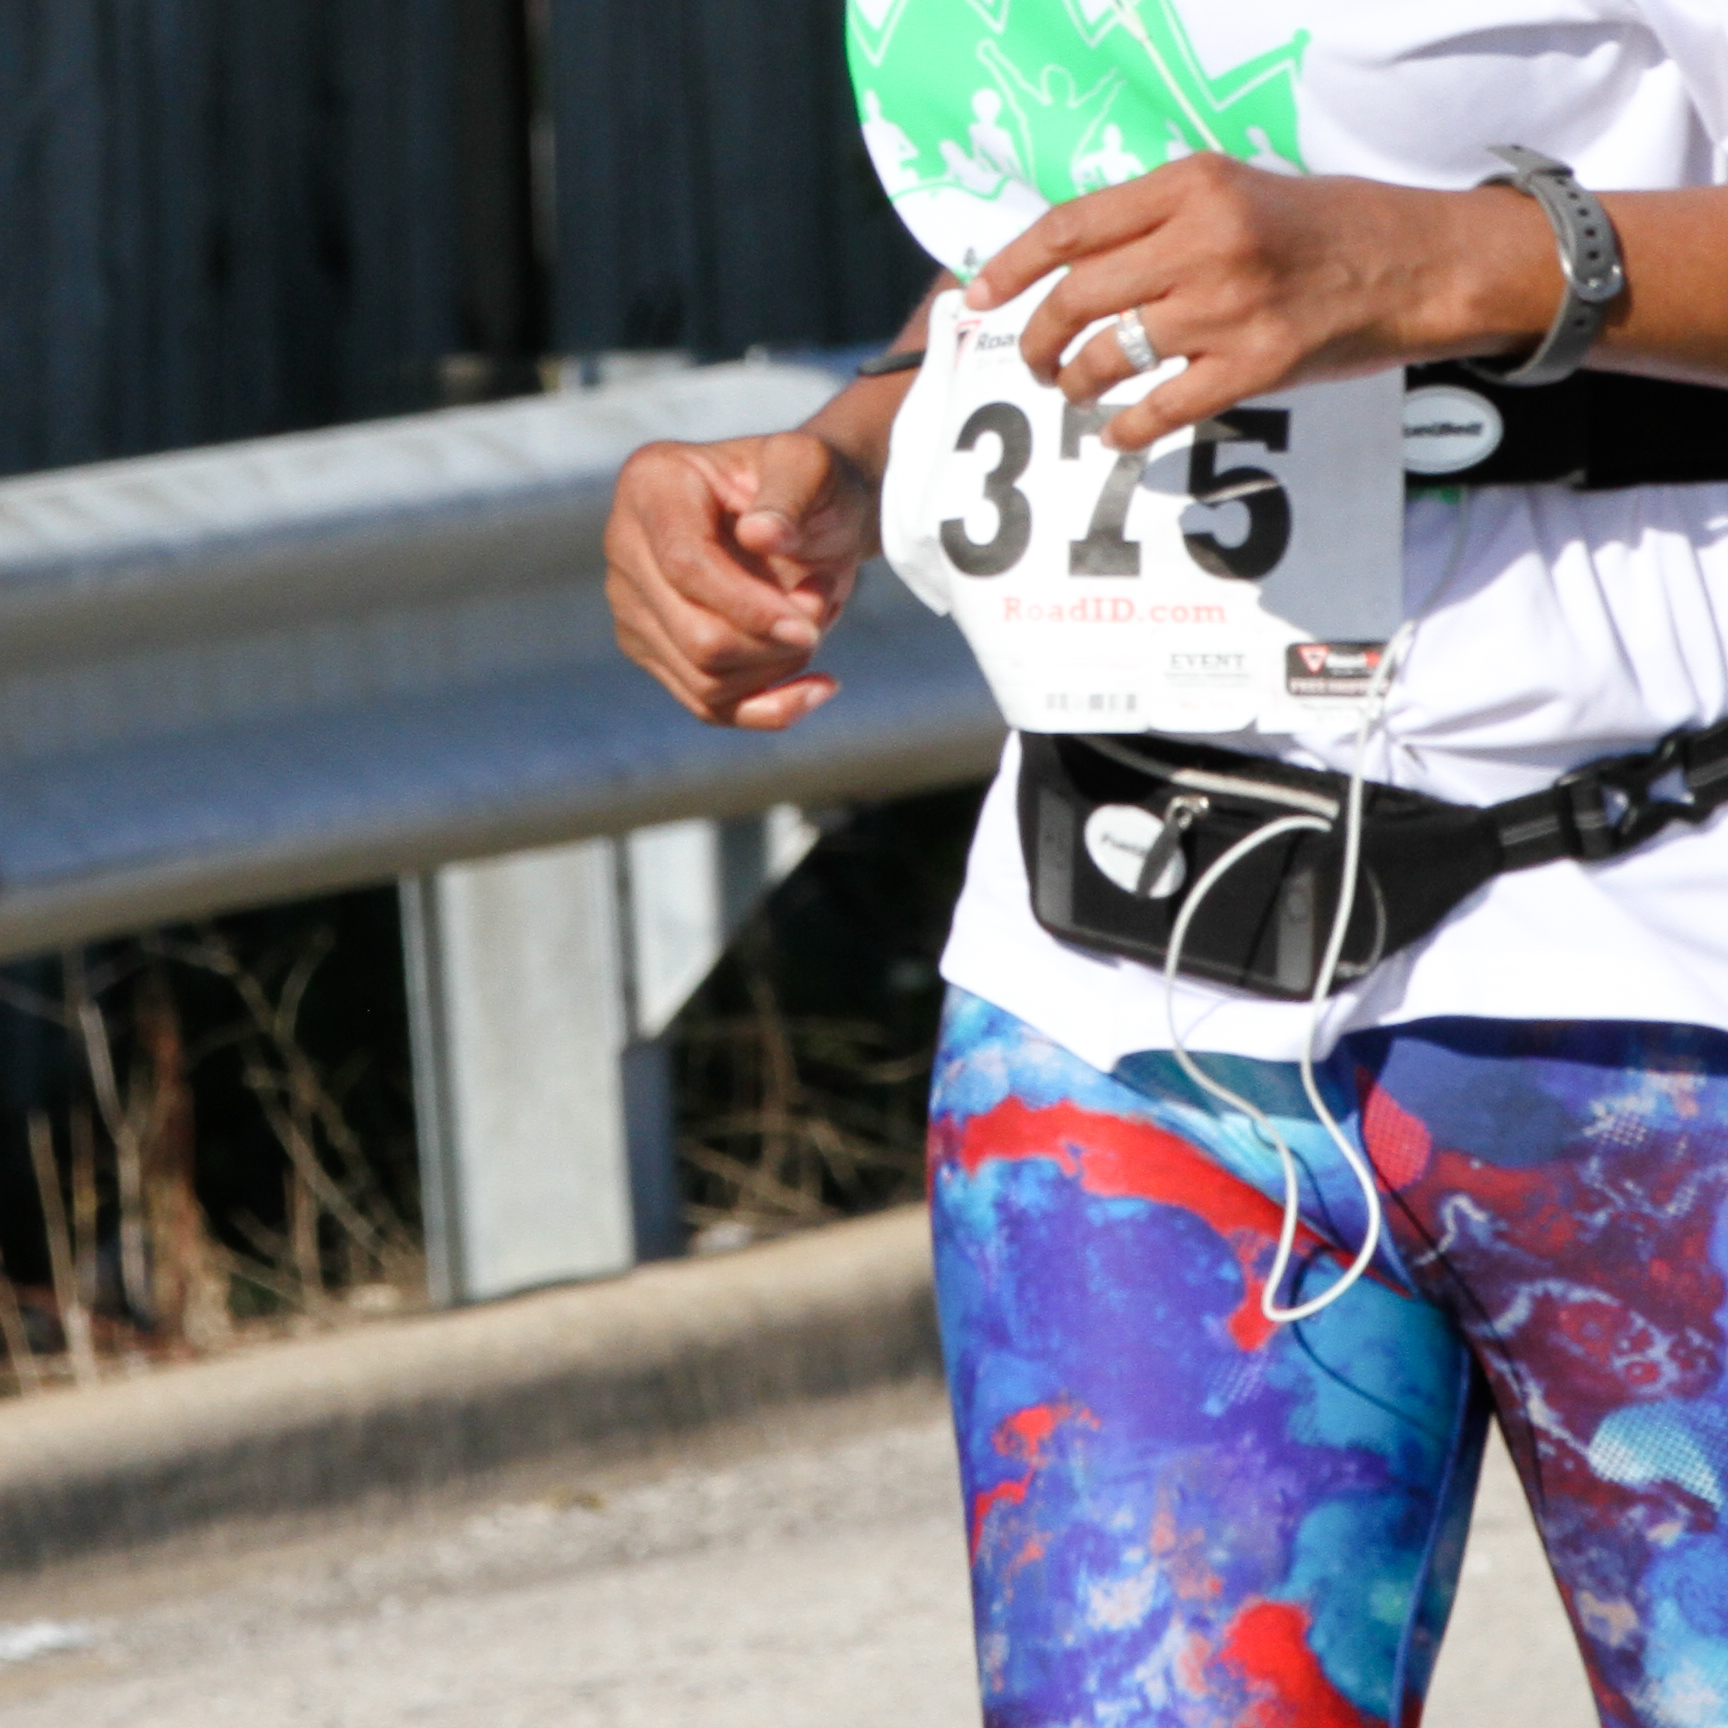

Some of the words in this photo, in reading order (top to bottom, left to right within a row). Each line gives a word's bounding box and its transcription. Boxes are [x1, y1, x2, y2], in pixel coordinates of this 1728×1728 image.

[940, 401, 1292, 580] 375
[1002, 595, 1228, 624] RoadID.com
[1169, 653, 1246, 669] EVENT
